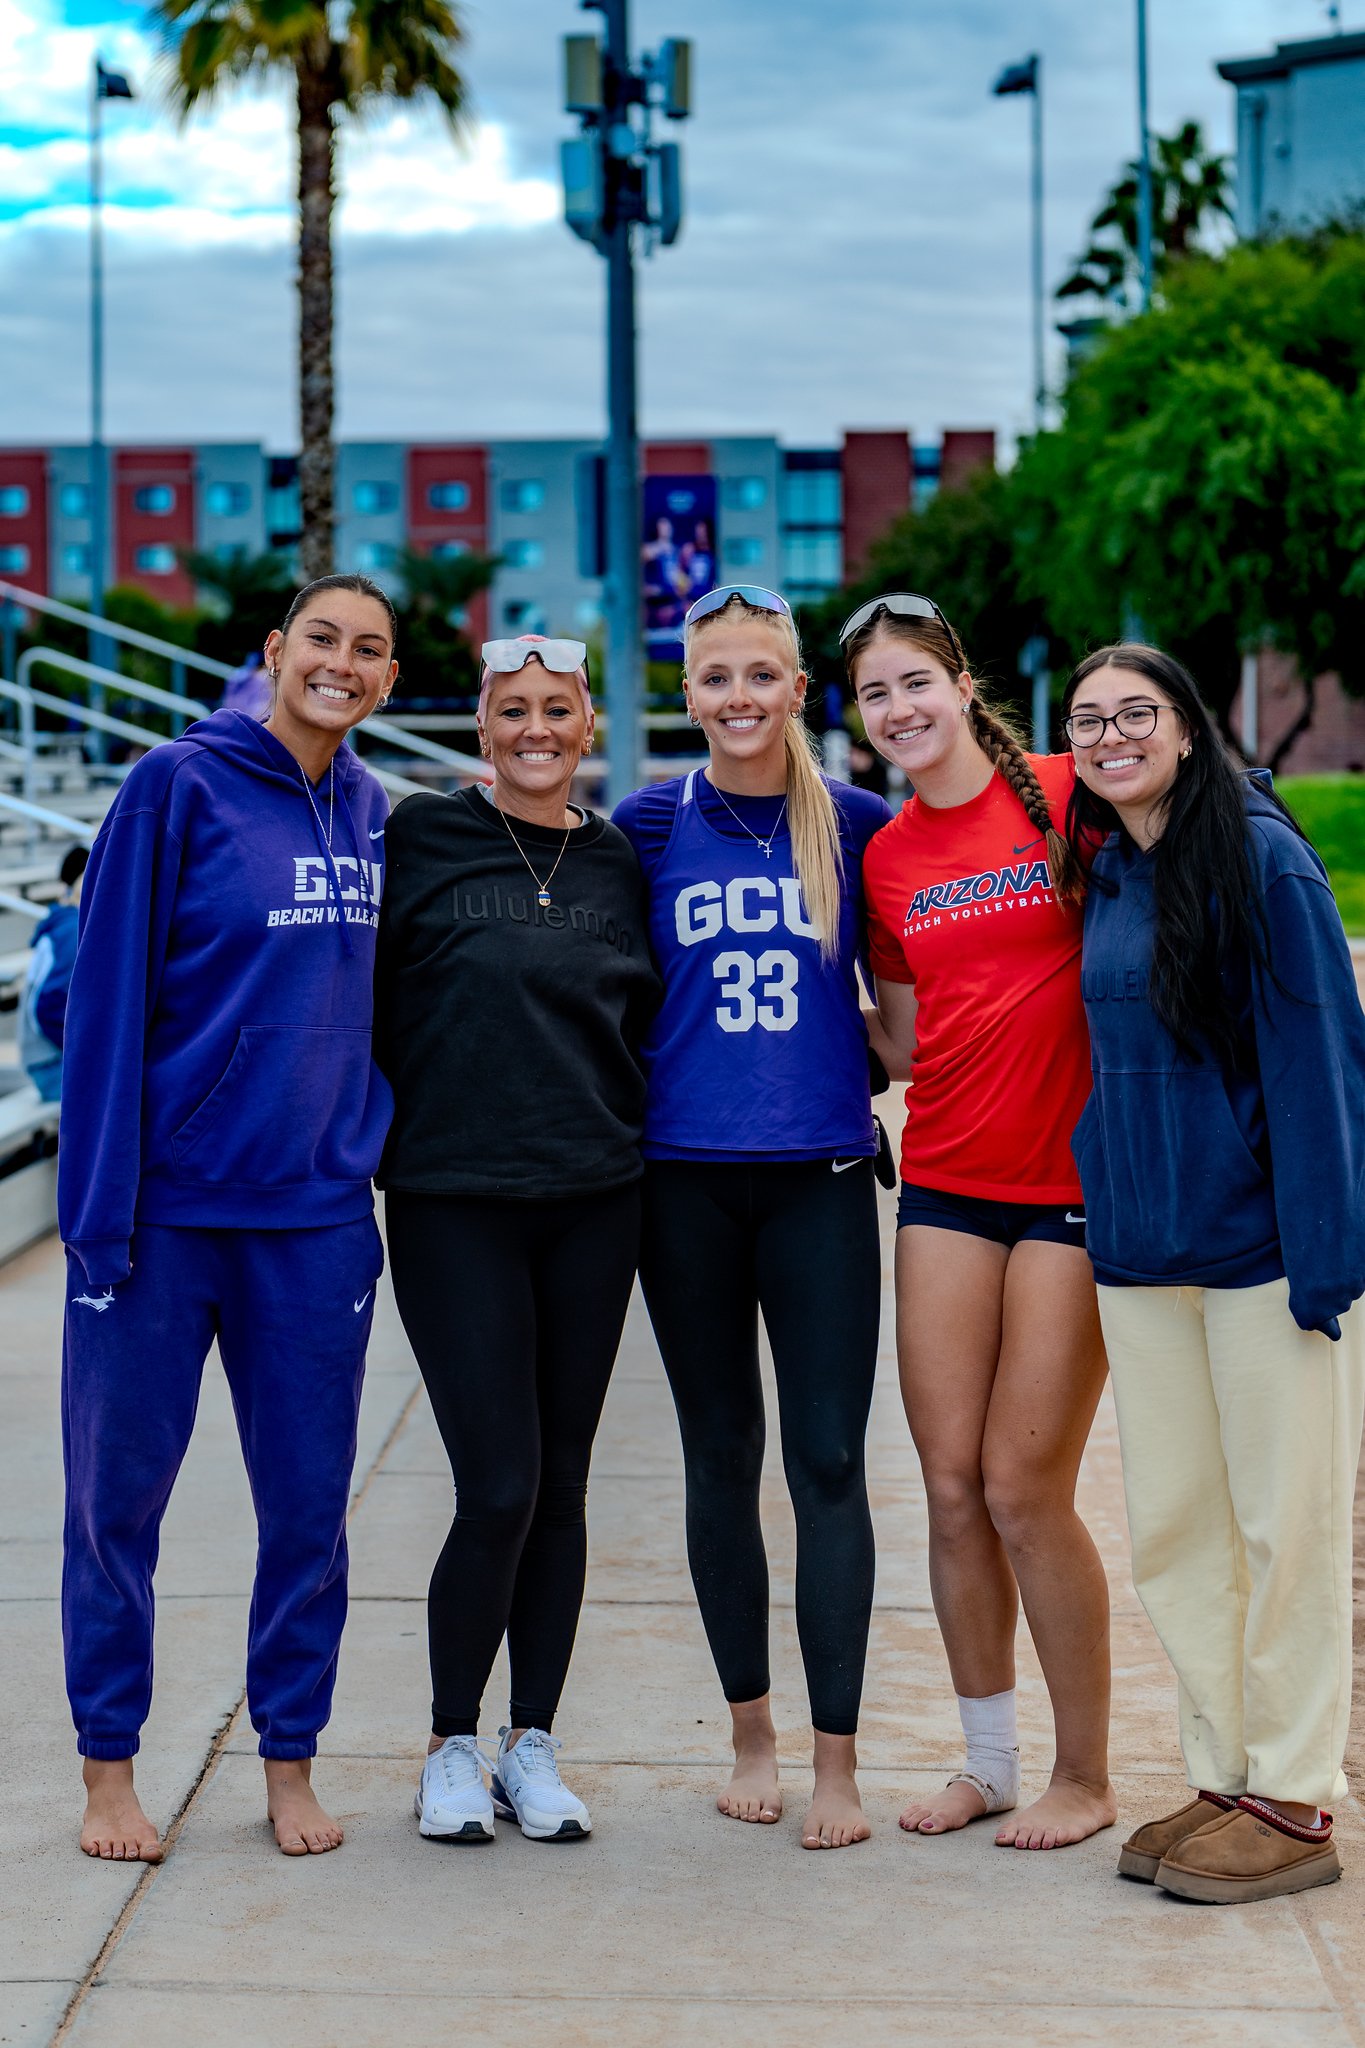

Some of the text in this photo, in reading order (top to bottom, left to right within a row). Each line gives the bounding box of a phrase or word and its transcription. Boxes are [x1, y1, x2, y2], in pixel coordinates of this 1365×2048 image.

[292, 856, 382, 907] GCU
[904, 860, 1053, 922] ARIZONA
[266, 907, 380, 929] BEACH VLLEB
[451, 886, 632, 957] lululemon
[903, 894, 1064, 937] BEACH VOLLEYBAL
[712, 949, 799, 1033] 33
[1254, 1823, 1272, 1838] UGG
